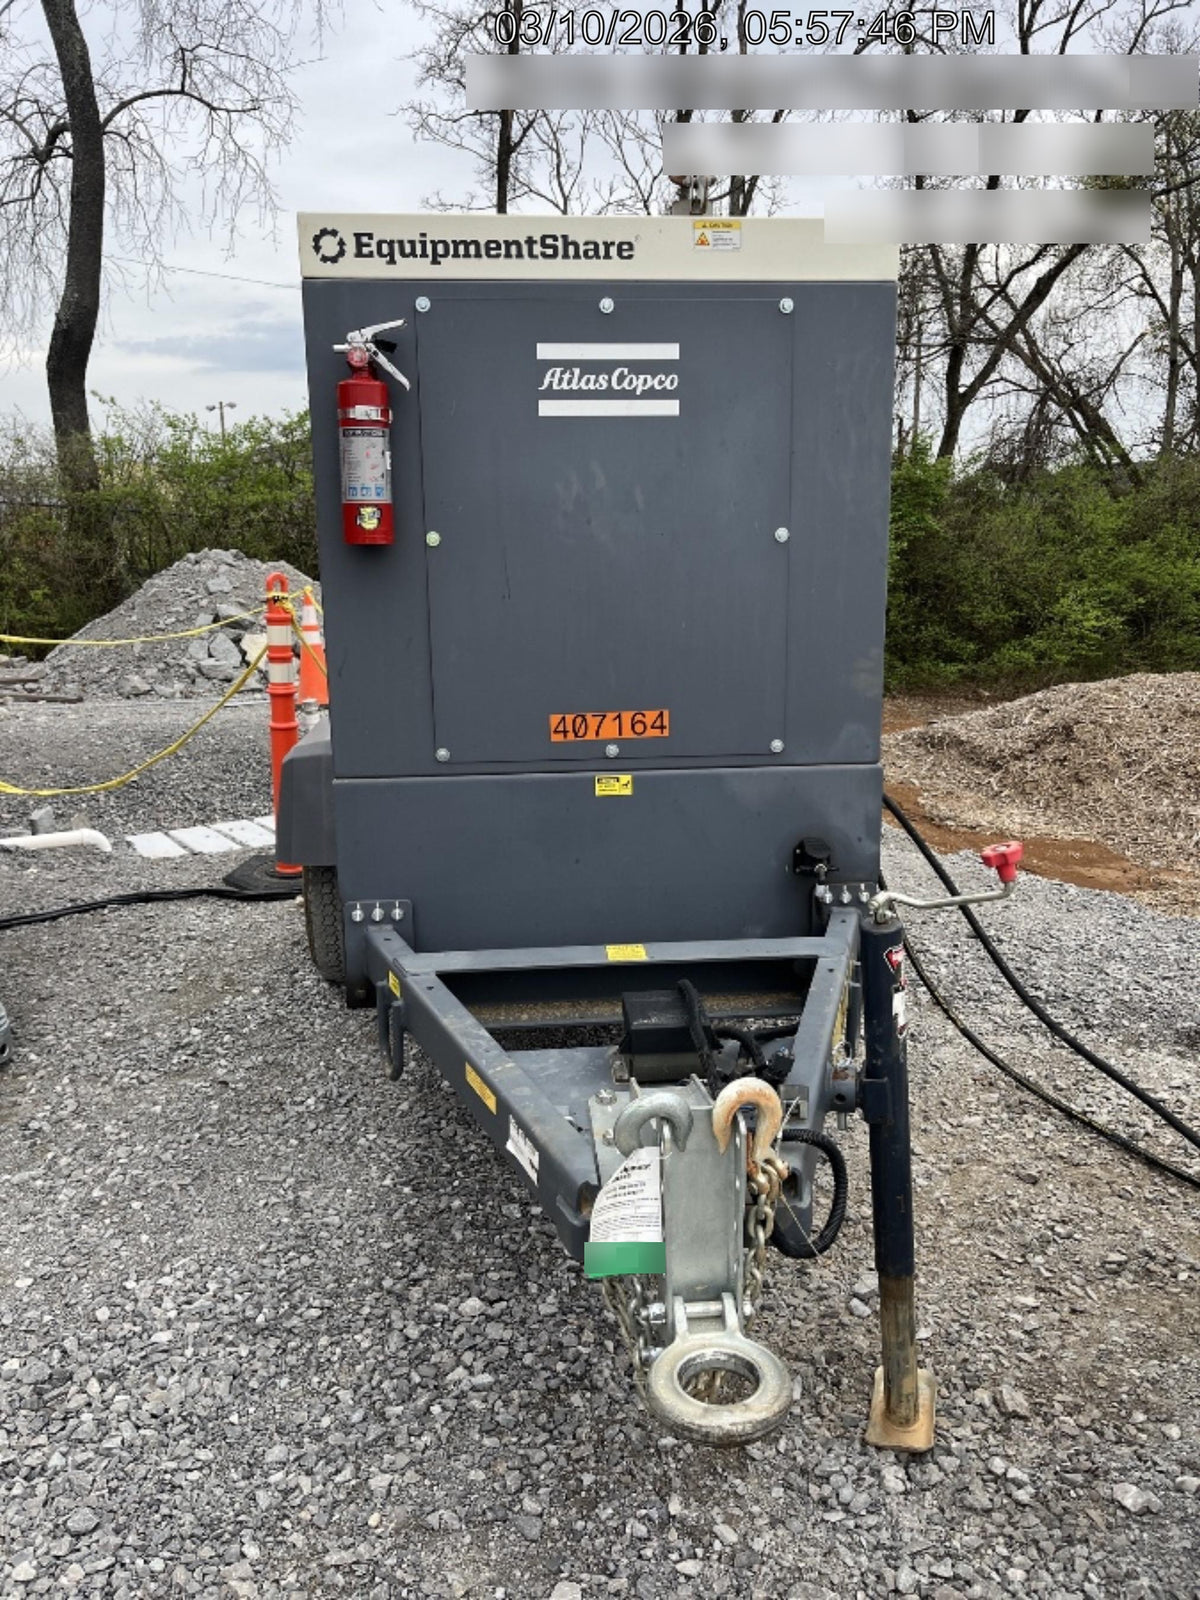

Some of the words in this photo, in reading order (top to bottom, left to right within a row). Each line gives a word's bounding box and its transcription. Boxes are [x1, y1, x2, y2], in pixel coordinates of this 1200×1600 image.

[353, 232, 635, 266] EquipmentShare
[538, 367, 609, 391] Atlas
[611, 367, 679, 396] Copco
[552, 710, 668, 739] 407164
